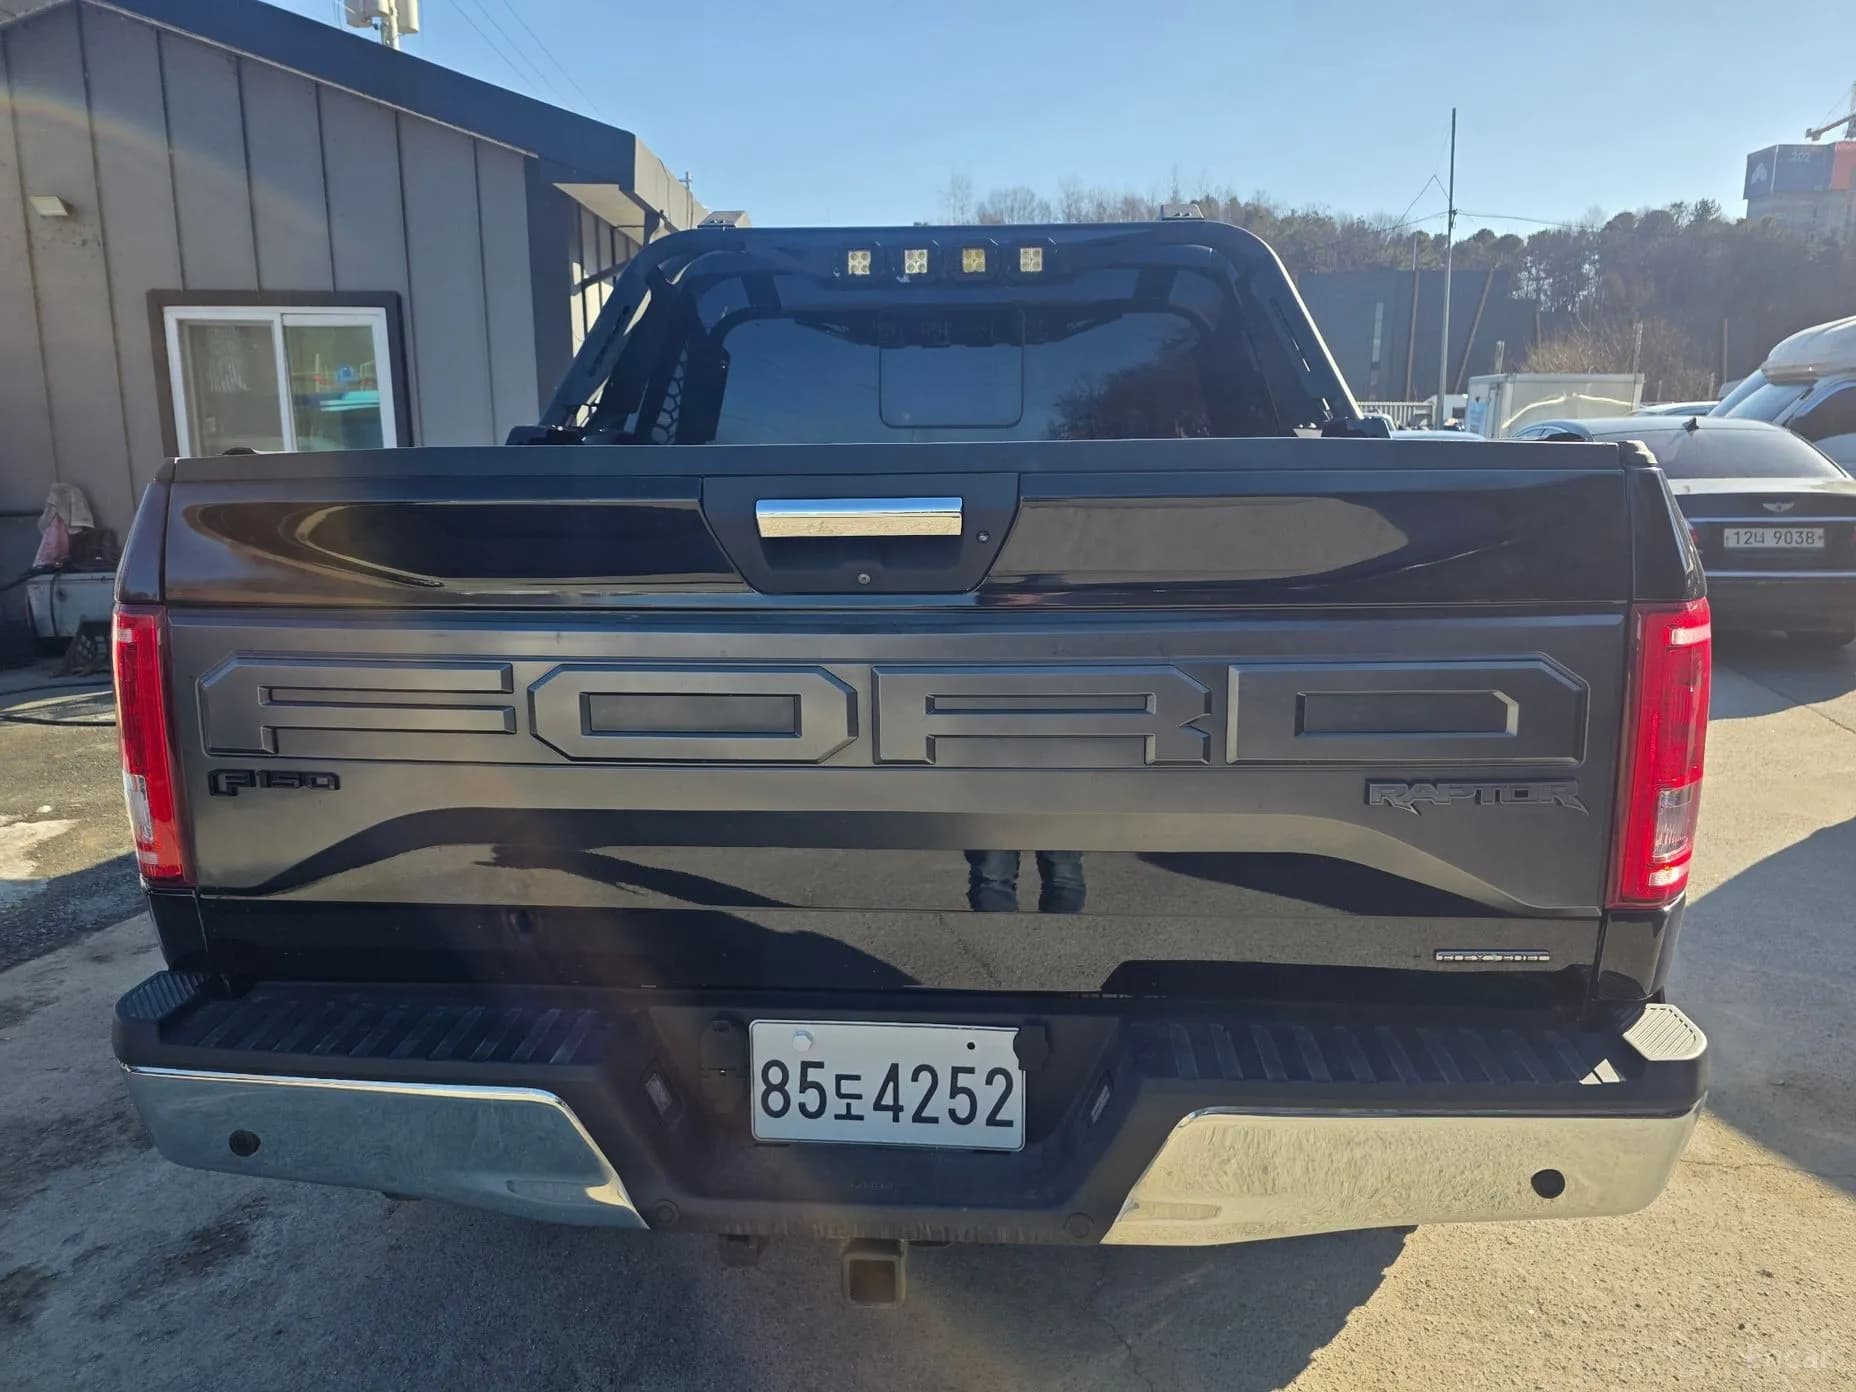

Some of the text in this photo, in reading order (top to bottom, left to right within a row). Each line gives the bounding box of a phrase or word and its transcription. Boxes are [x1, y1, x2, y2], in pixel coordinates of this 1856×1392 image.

[1773, 530, 1815, 545] 9038
[197, 651, 1590, 767] FORD
[1366, 779, 1589, 816] RAPTOR
[760, 1059, 1014, 1127] 85도4252
